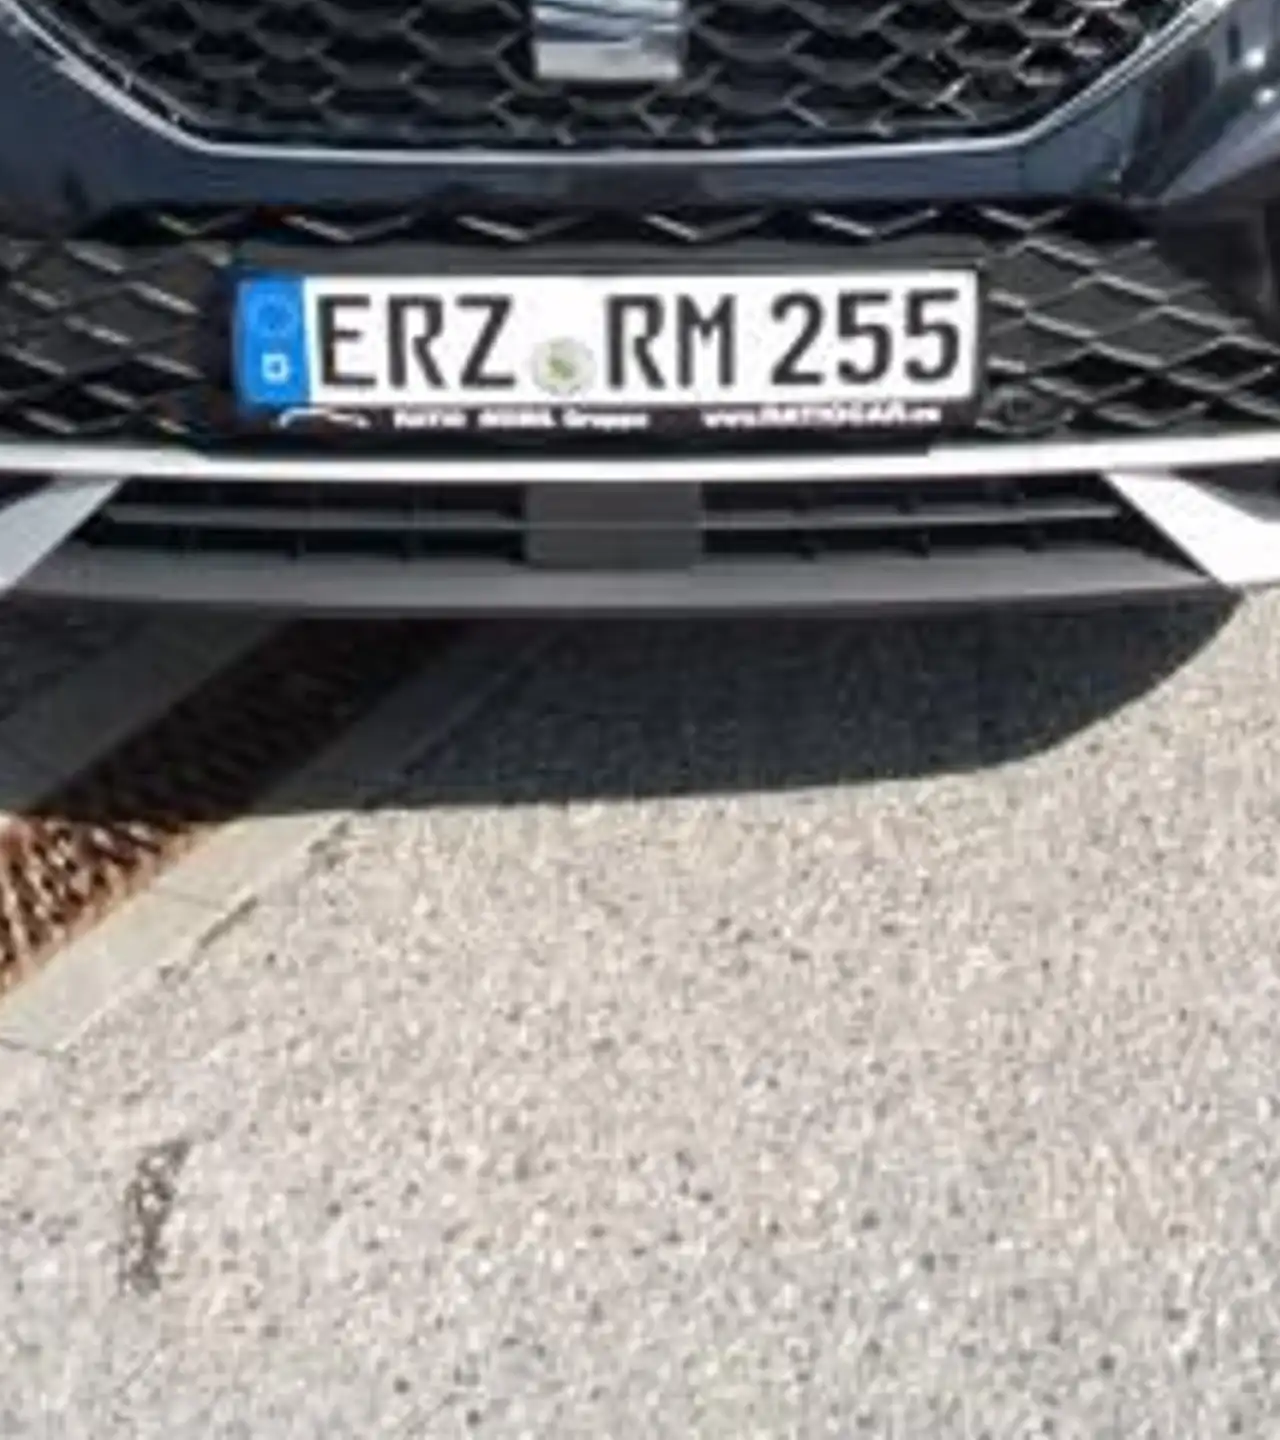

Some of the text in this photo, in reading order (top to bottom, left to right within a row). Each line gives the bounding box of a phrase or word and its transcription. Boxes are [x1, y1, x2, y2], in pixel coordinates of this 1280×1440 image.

[317, 289, 961, 390] ERZ RM 255
